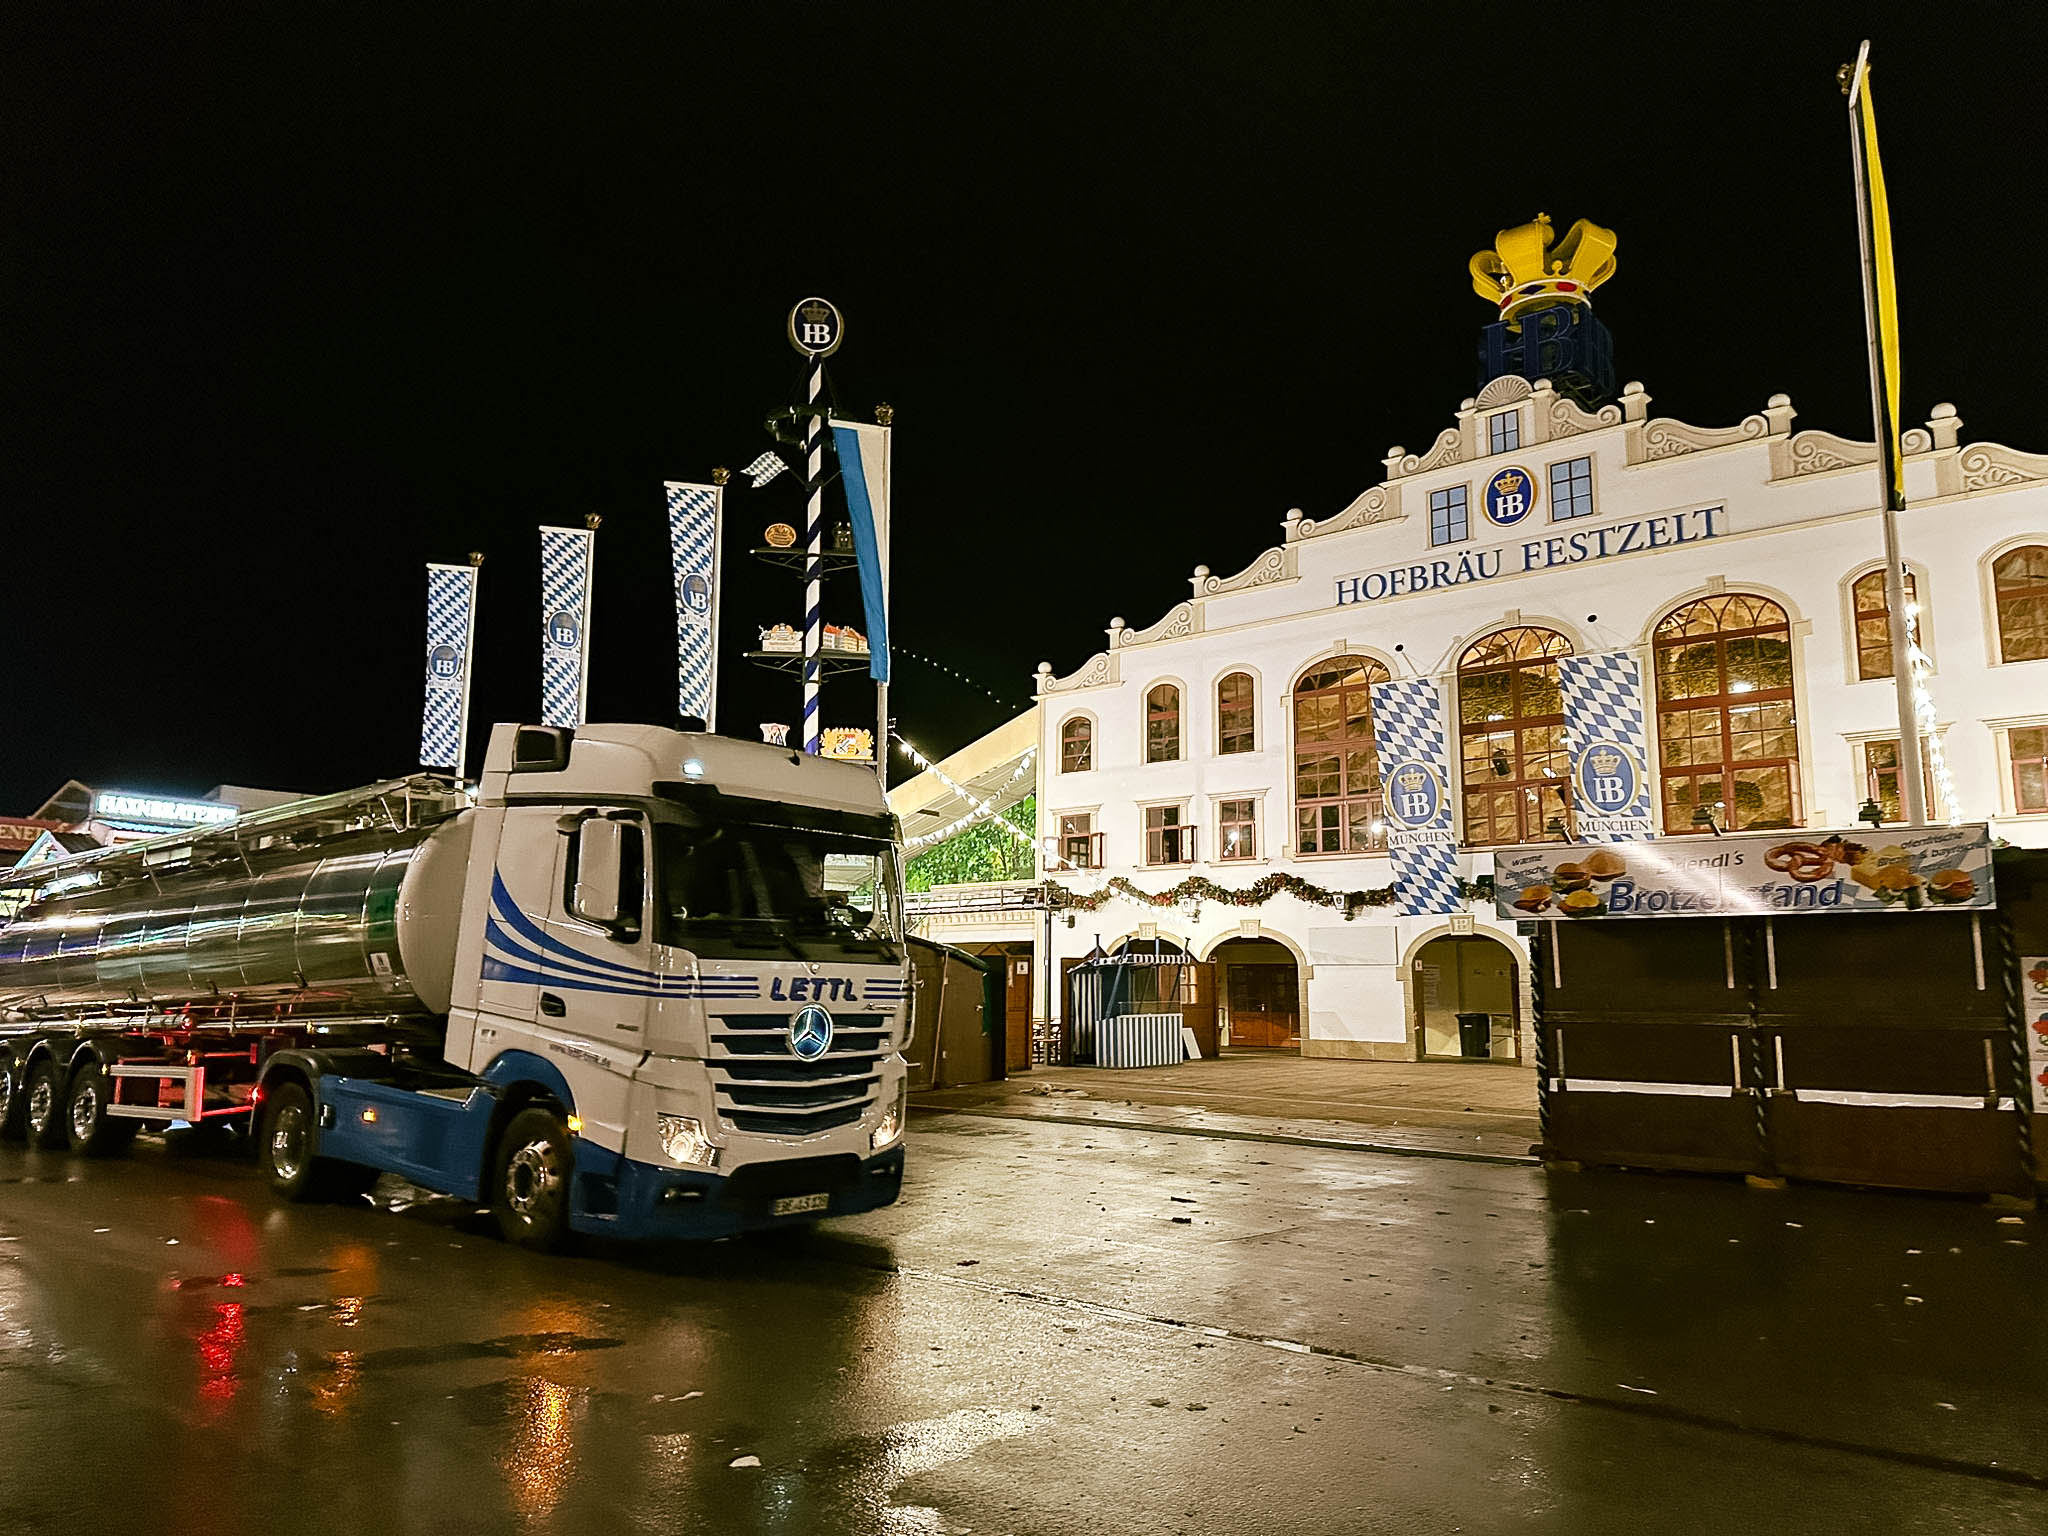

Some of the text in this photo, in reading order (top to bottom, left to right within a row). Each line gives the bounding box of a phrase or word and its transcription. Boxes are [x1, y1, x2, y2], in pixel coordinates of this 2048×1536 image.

[803, 323, 830, 344] HB
[1482, 306, 1574, 380] HB
[1496, 493, 1524, 518] HB
[1335, 505, 1725, 607] HOFBRÄU FESTZELT
[689, 590, 707, 610] HB
[556, 627, 575, 643] HB
[436, 659, 455, 674] HB
[1593, 776, 1625, 803] HB
[1400, 792, 1431, 818] HB
[1579, 819, 1650, 832] MÜNCHEN
[1388, 831, 1452, 846] MÜNCHEN
[770, 976, 858, 1001] LETTL
